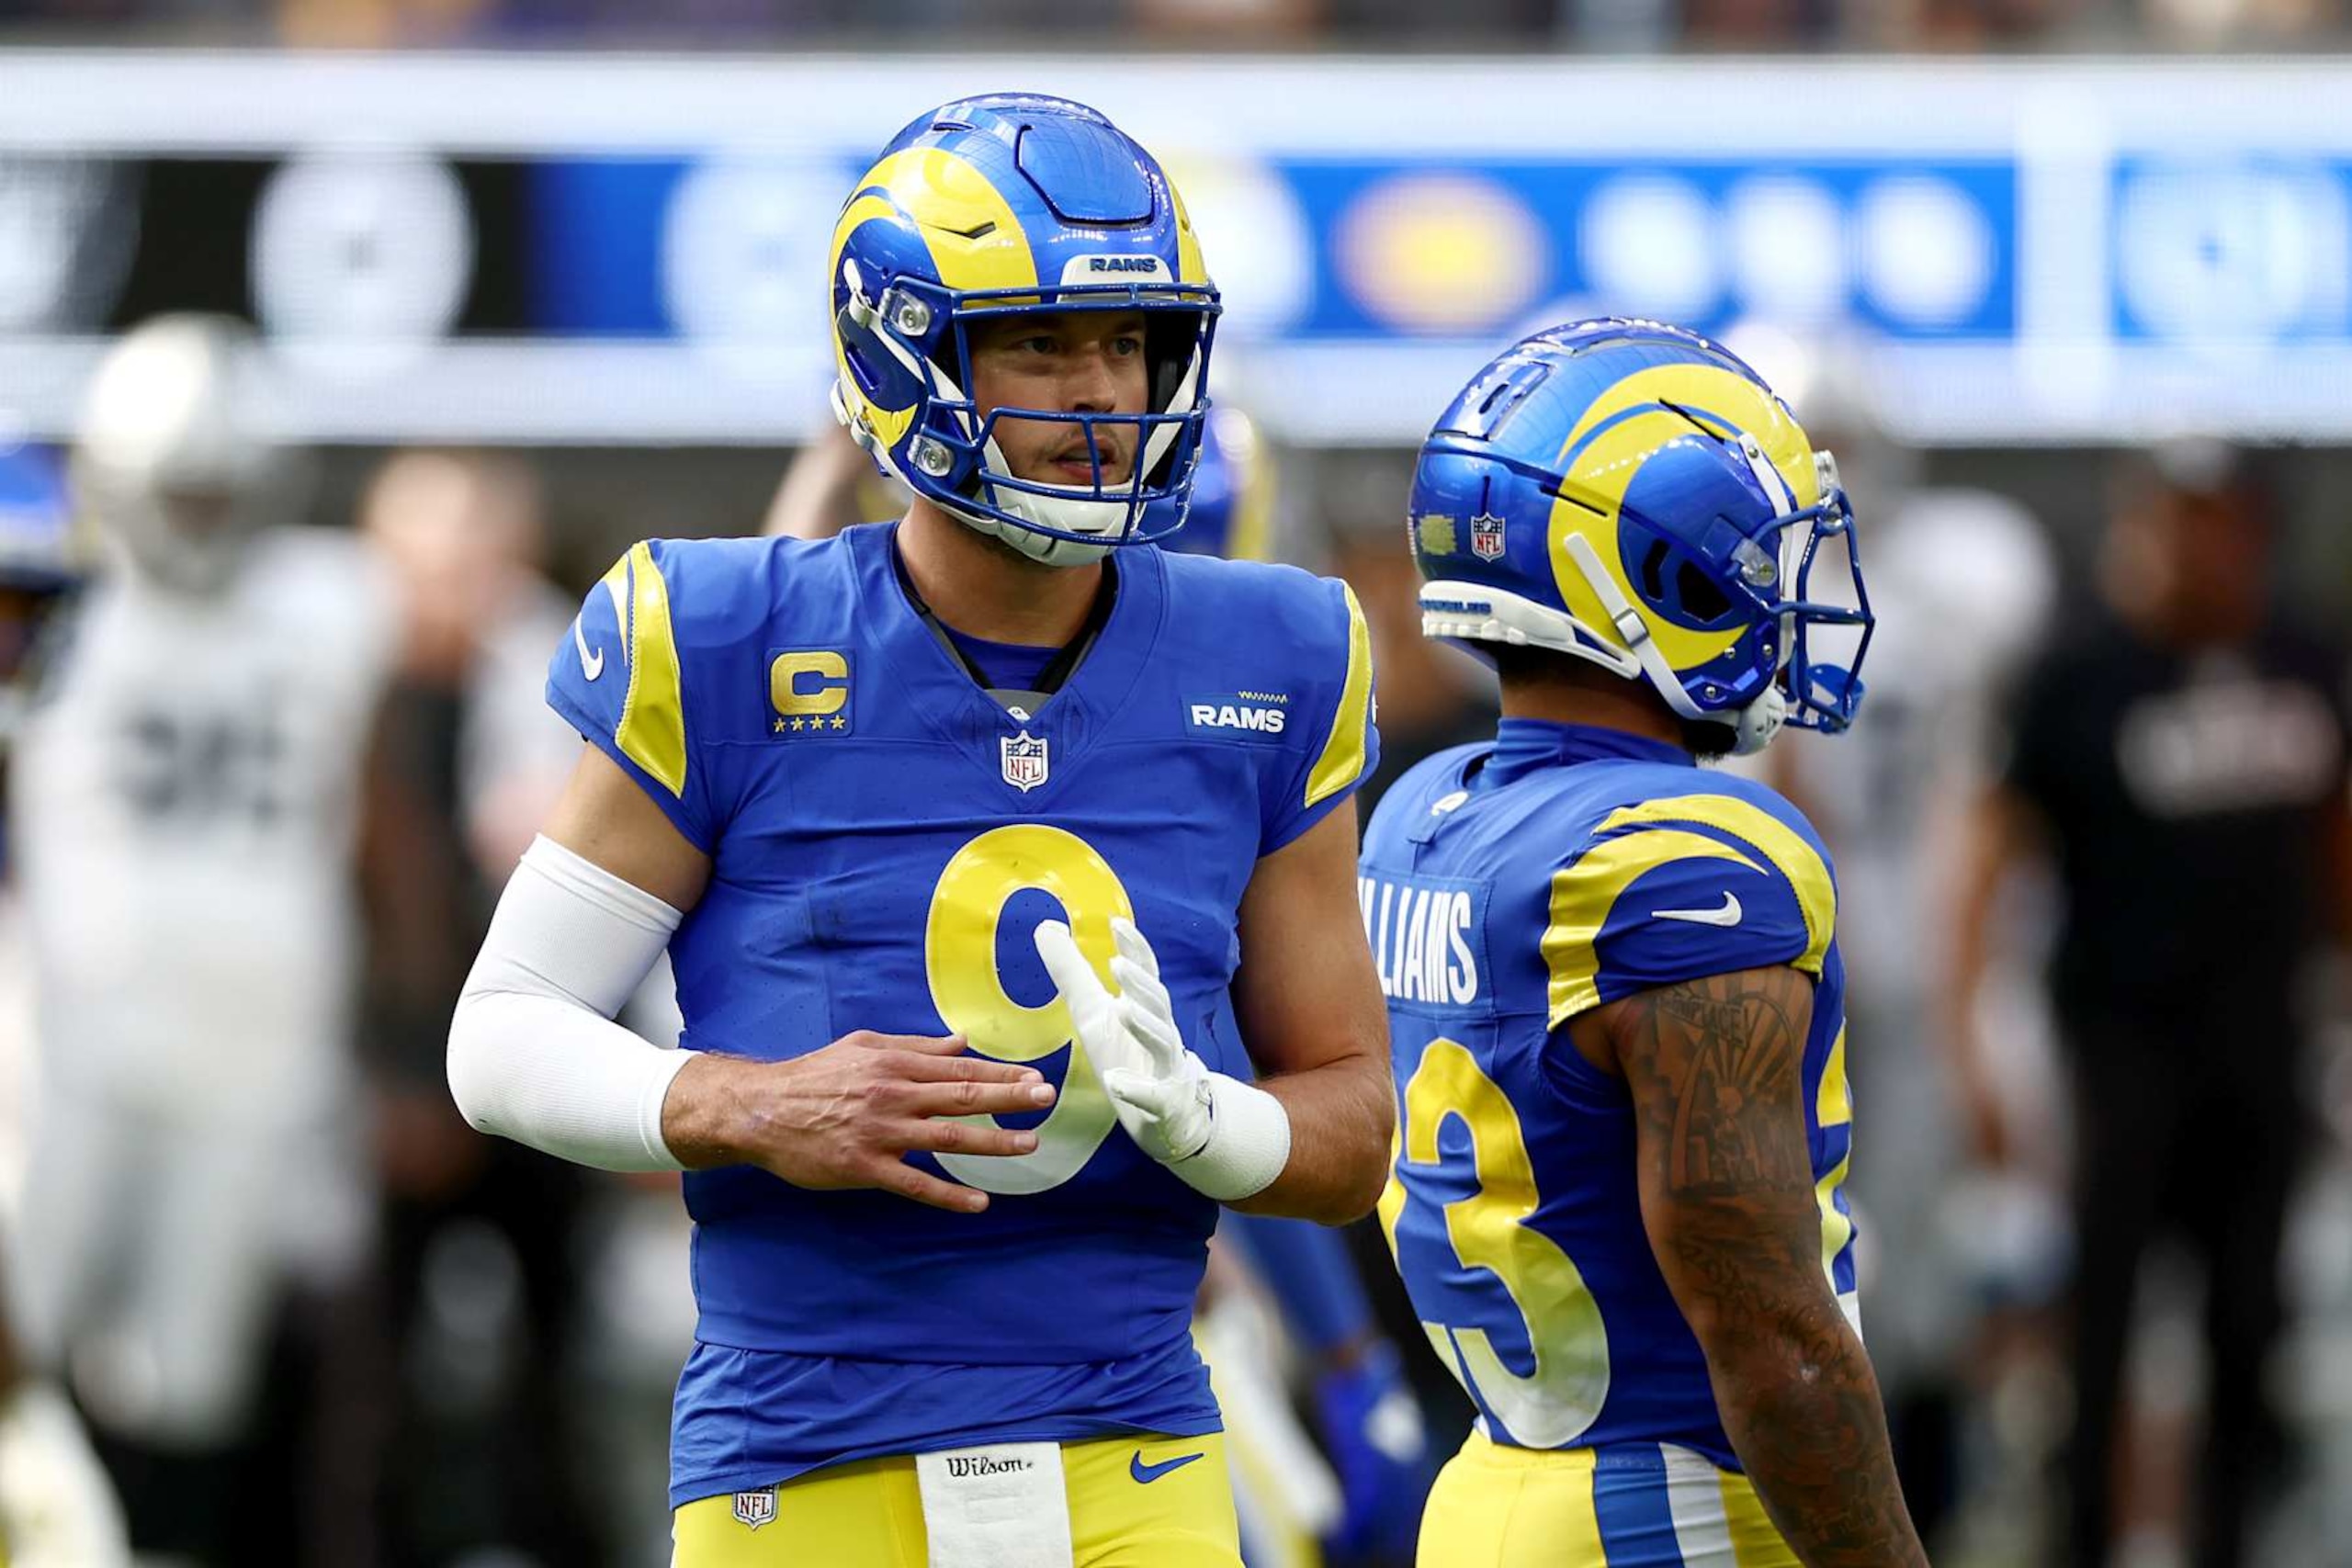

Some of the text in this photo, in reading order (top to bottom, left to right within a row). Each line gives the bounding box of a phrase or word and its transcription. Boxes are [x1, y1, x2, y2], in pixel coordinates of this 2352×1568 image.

[1090, 258, 1158, 272] RAMS
[770, 650, 849, 716] C
[1191, 705, 1286, 733] RAMS
[1010, 758, 1040, 780] NFL
[924, 823, 1136, 1194] 9
[1378, 1036, 1610, 1449] 3
[946, 1456, 1023, 1476] Wilson
[740, 1495, 770, 1517] NFL
